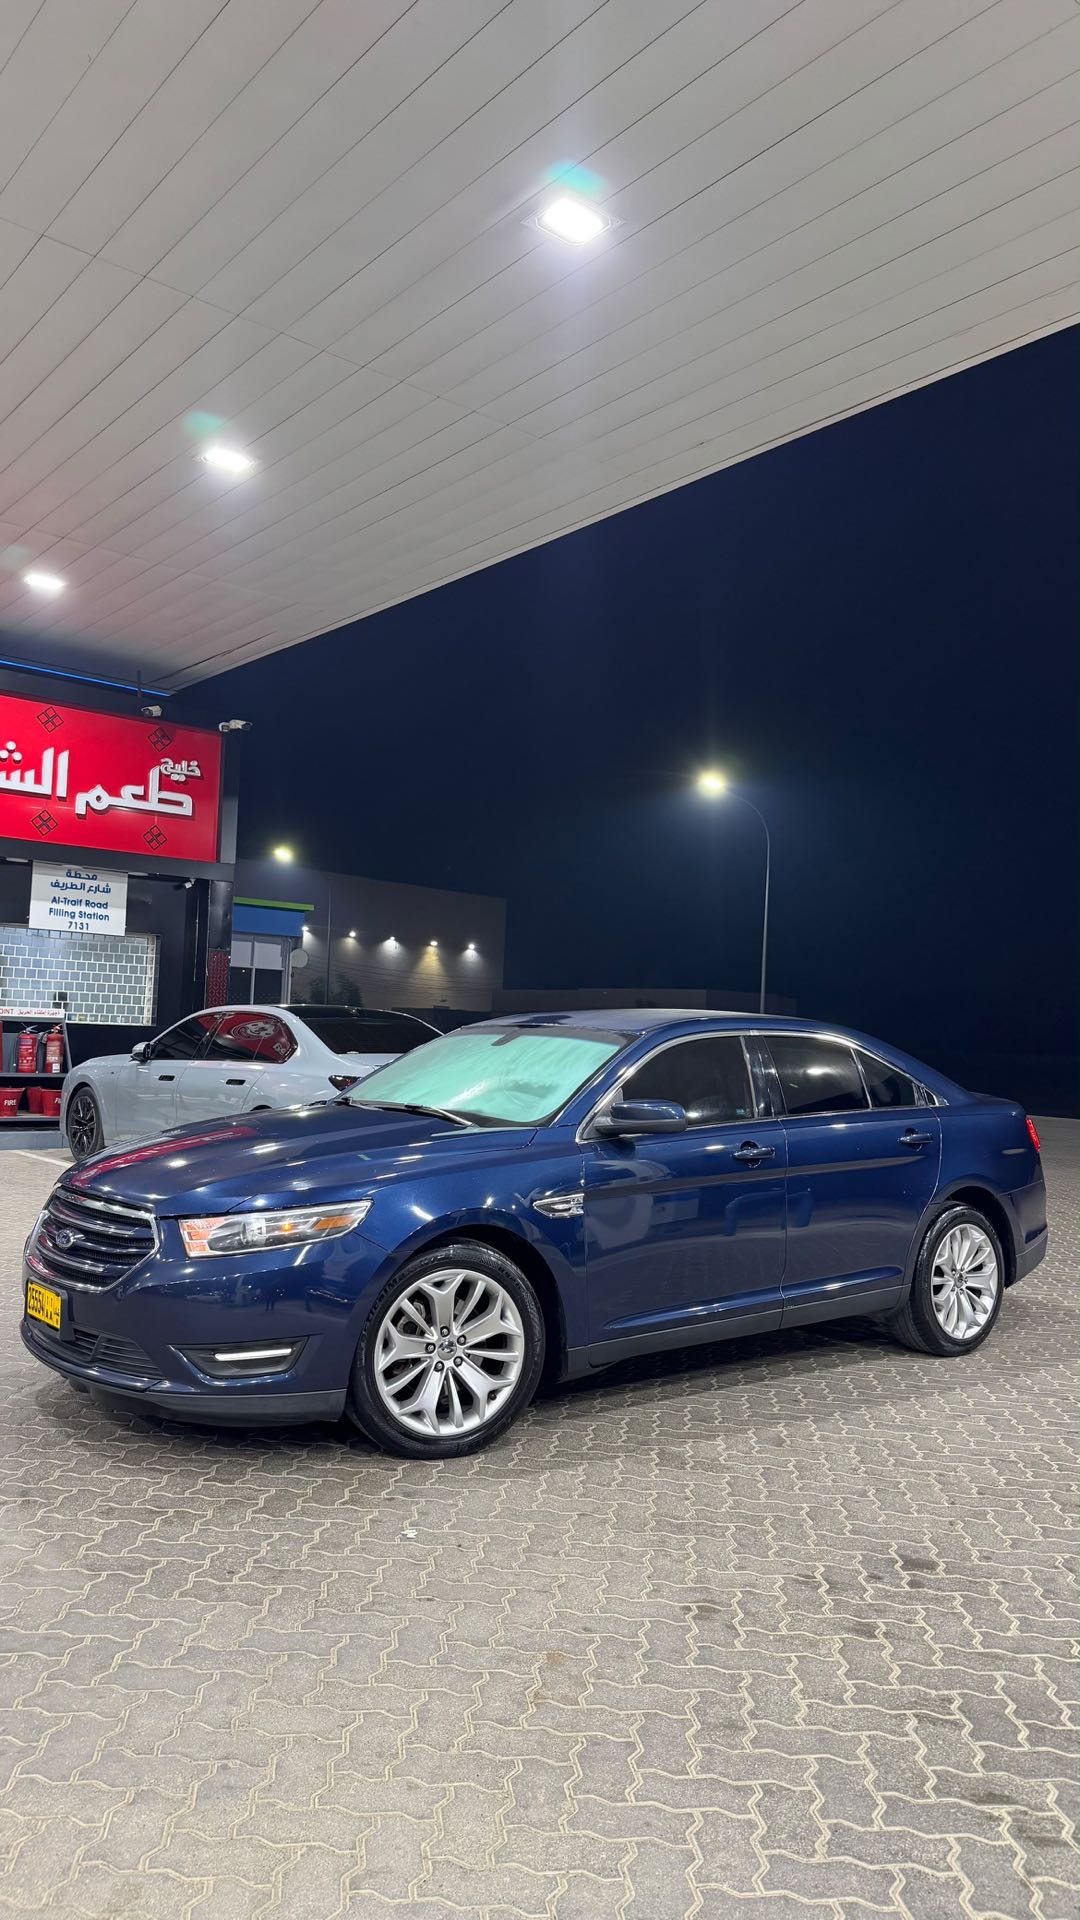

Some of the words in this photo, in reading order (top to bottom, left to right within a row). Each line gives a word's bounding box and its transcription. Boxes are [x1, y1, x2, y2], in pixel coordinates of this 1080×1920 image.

[0, 741, 70, 798] الش
[160, 757, 201, 782] خليج
[75, 765, 193, 816] طعم
[66, 869, 98, 881] محطة
[50, 879, 86, 890] الطريف
[87, 883, 111, 894] شارع
[51, 895, 83, 907] Al-Traif
[85, 899, 109, 910] Road
[49, 908, 76, 919] Filling
[78, 910, 110, 921] Station
[68, 921, 89, 931] 7131
